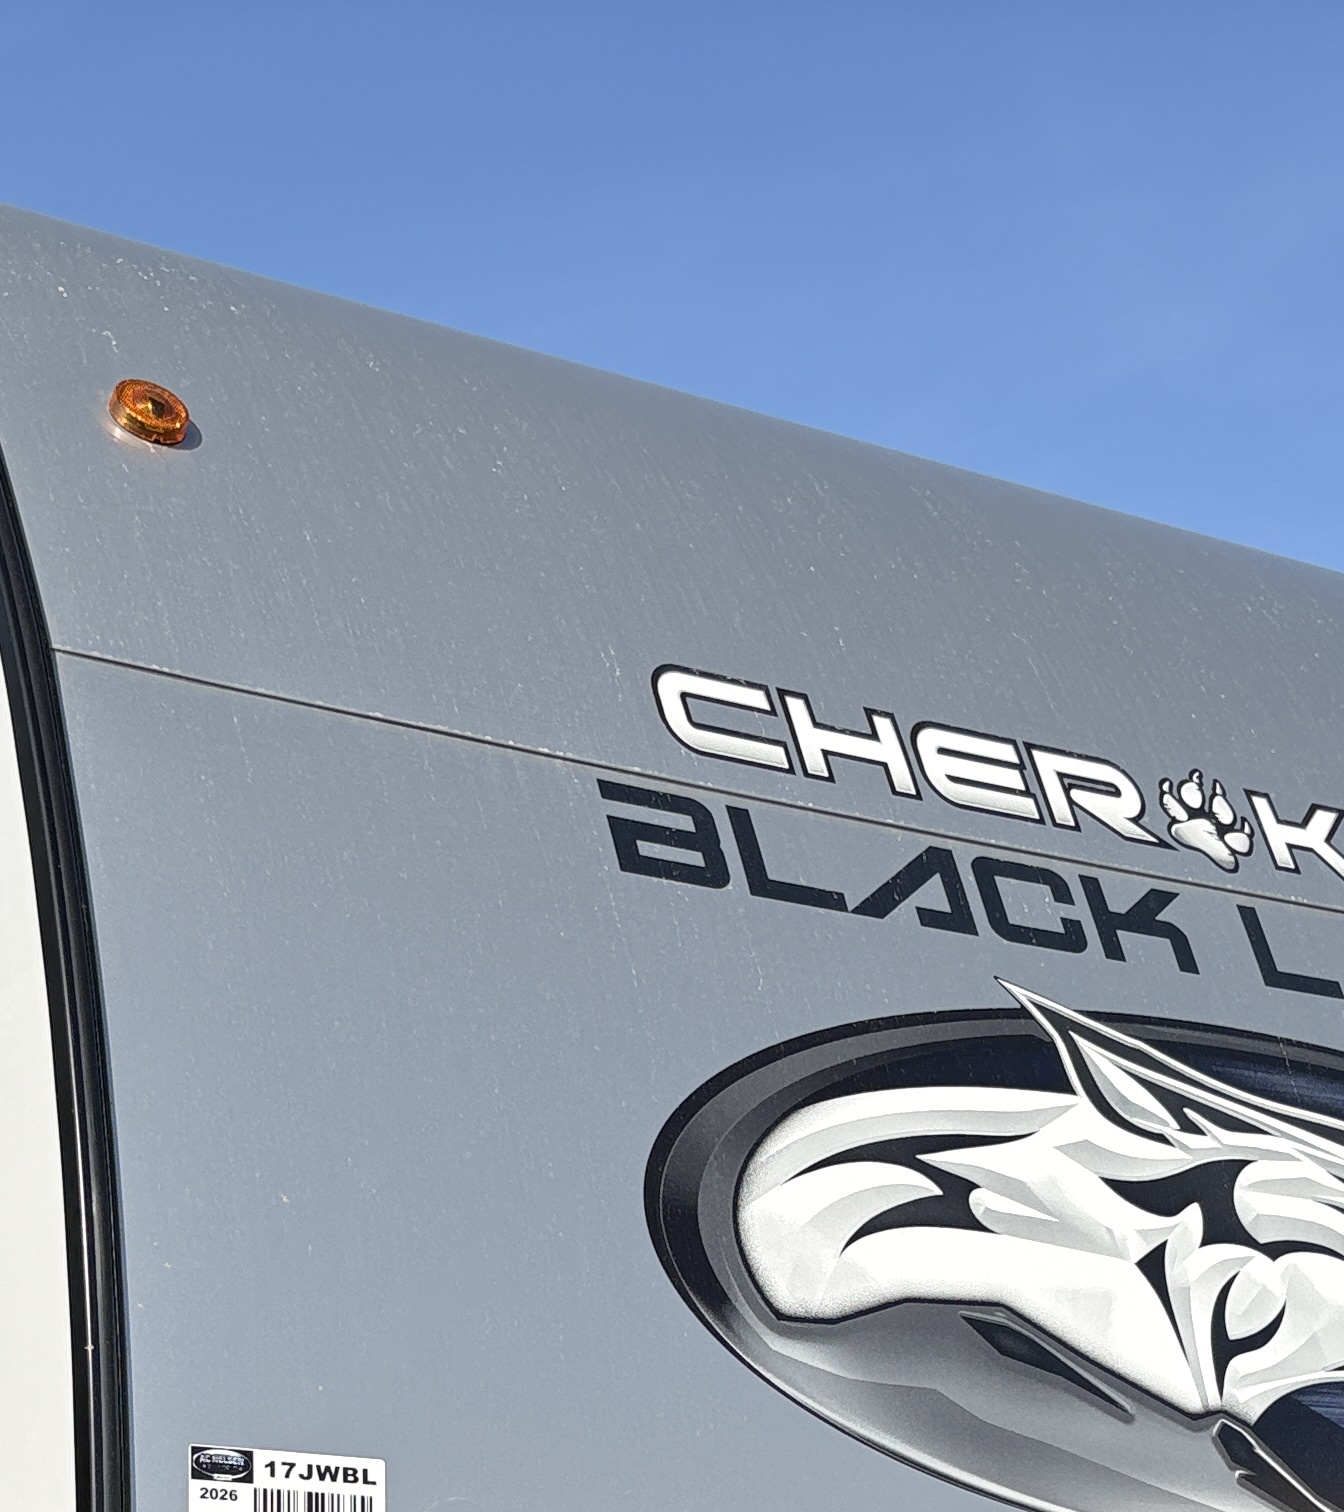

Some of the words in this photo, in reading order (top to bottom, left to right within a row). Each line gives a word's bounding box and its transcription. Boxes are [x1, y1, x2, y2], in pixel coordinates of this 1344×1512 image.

[597, 779, 1201, 975] BLACK
[264, 1460, 377, 1486] 17JWBL
[200, 1488, 238, 1501] 2026
